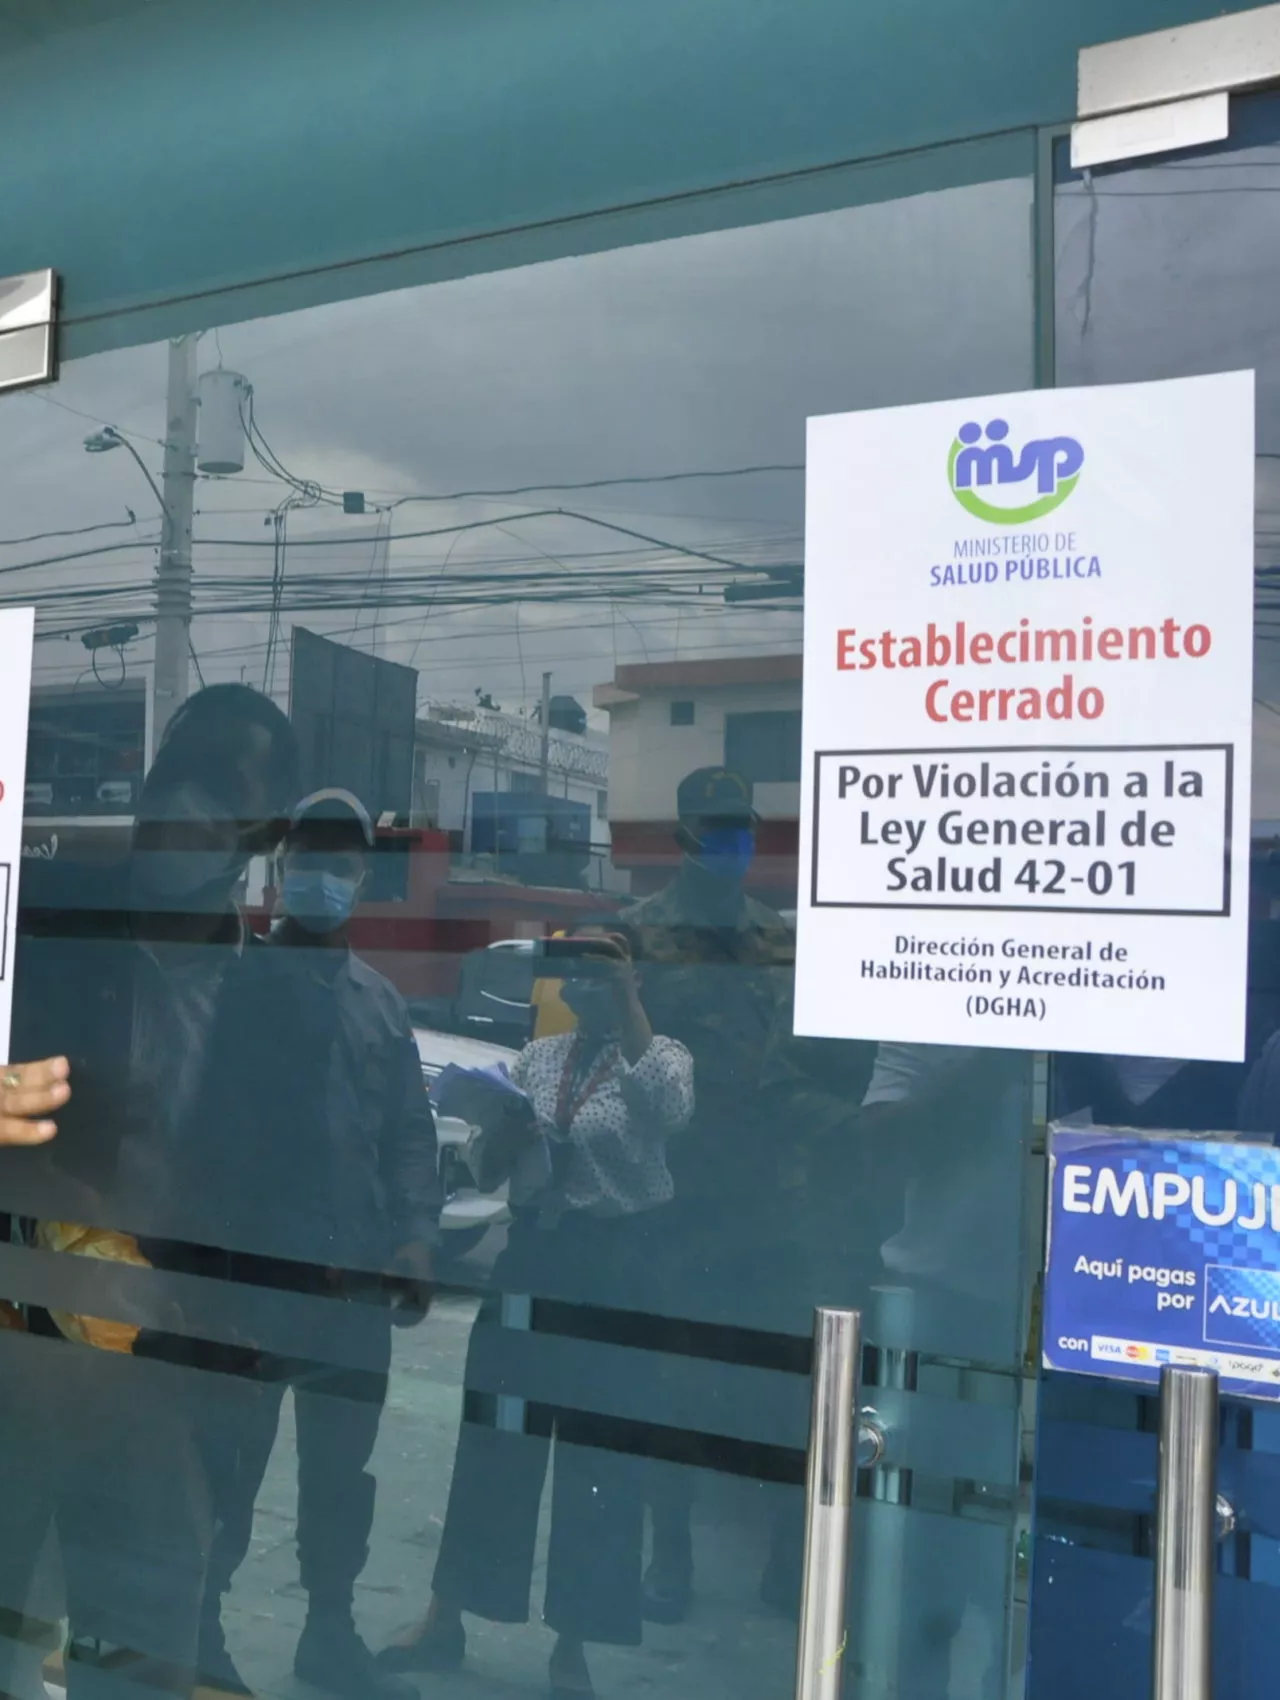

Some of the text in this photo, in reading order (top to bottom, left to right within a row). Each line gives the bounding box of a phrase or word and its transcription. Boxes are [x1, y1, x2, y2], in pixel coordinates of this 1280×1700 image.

[953, 532, 1077, 558] MINISTERIO DE
[930, 555, 1102, 587] SALUD PÚBLICA
[836, 616, 1212, 672] Establecimiento
[925, 674, 1105, 723] Cerrado
[837, 760, 1204, 799] Por Violación a la
[859, 810, 1176, 854] Ley General de
[886, 857, 1136, 897] Salud 42-01
[894, 936, 1128, 962] Dirección General de
[860, 961, 1166, 991] Habilitación y Acreditación
[966, 995, 1047, 1021] (DGHA)
[1074, 1255, 1196, 1287] Aquí pagas
[1157, 1291, 1195, 1311] por
[1058, 1336, 1088, 1352] con
[1098, 1344, 1121, 1353] VISA
